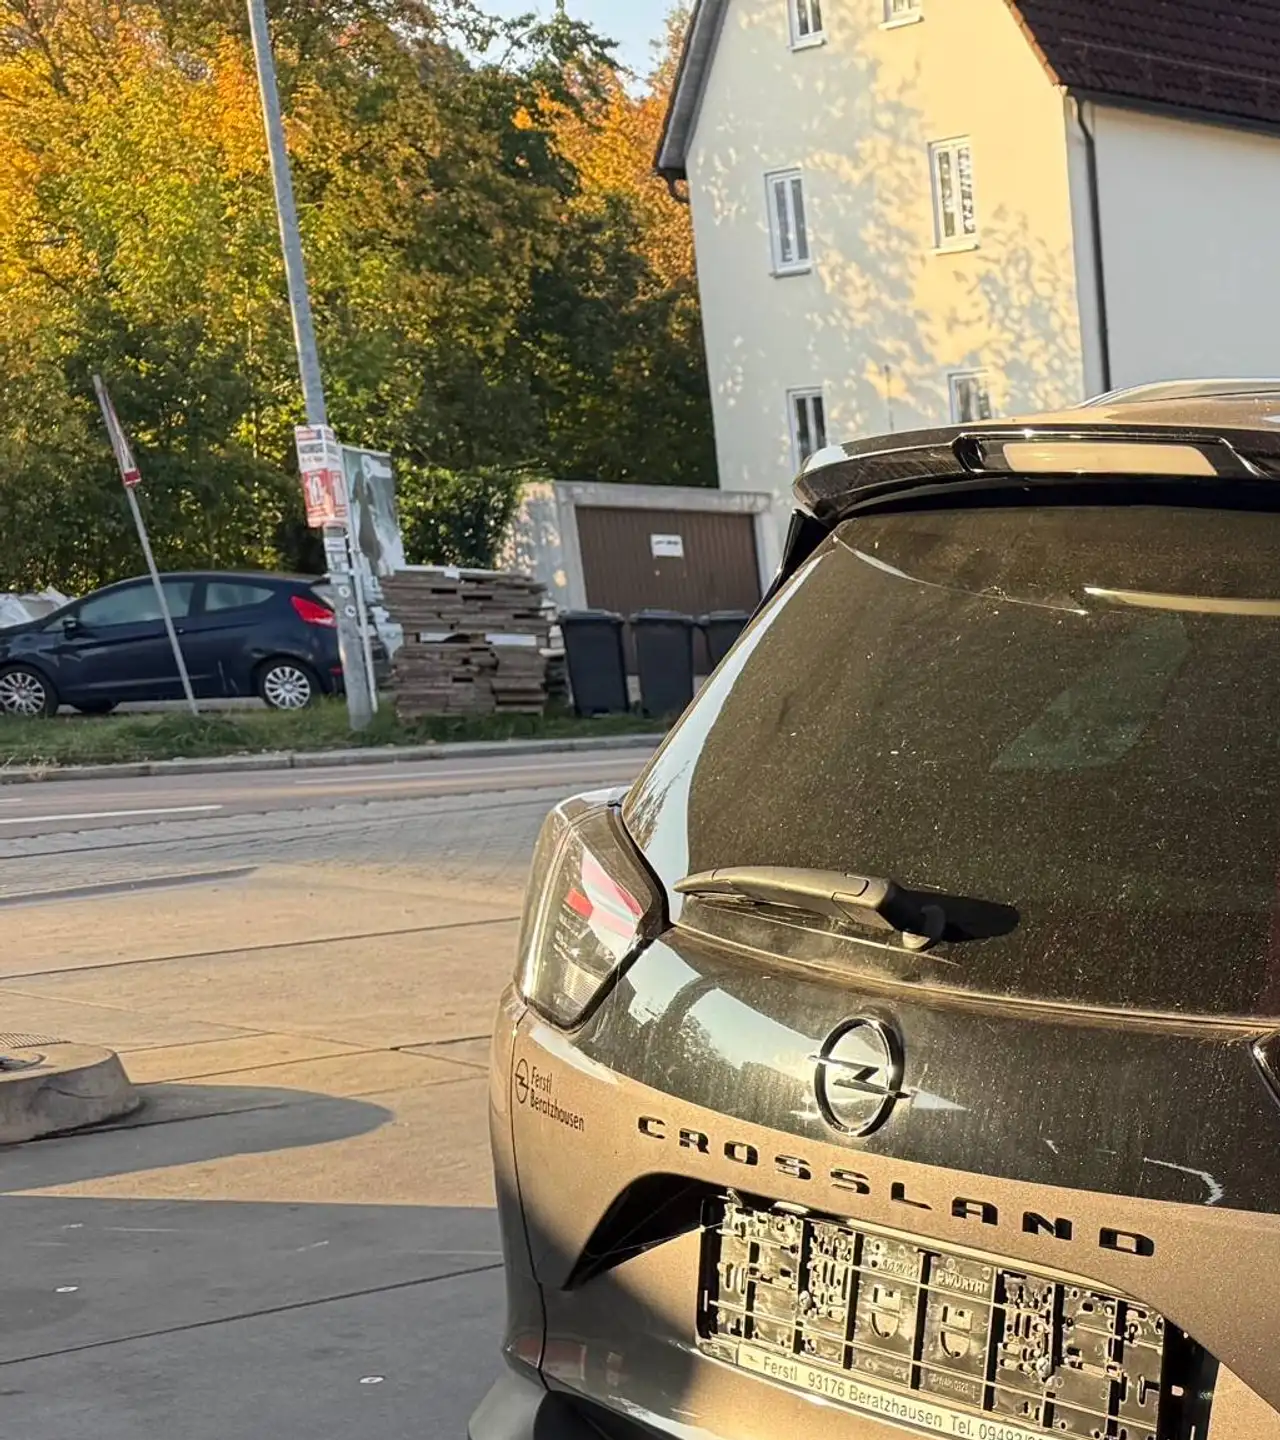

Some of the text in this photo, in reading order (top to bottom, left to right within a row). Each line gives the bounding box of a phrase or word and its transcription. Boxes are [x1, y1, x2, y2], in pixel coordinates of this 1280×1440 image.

[530, 1088, 584, 1132] Beratzhausen
[531, 1066, 552, 1094] Ferstl
[637, 1115, 1154, 1257] CROSSLAND
[763, 1356, 798, 1382] Ferstl
[808, 1371, 845, 1397] 93176
[849, 1384, 942, 1427] Beratzhausen
[950, 1415, 974, 1437] Tel.
